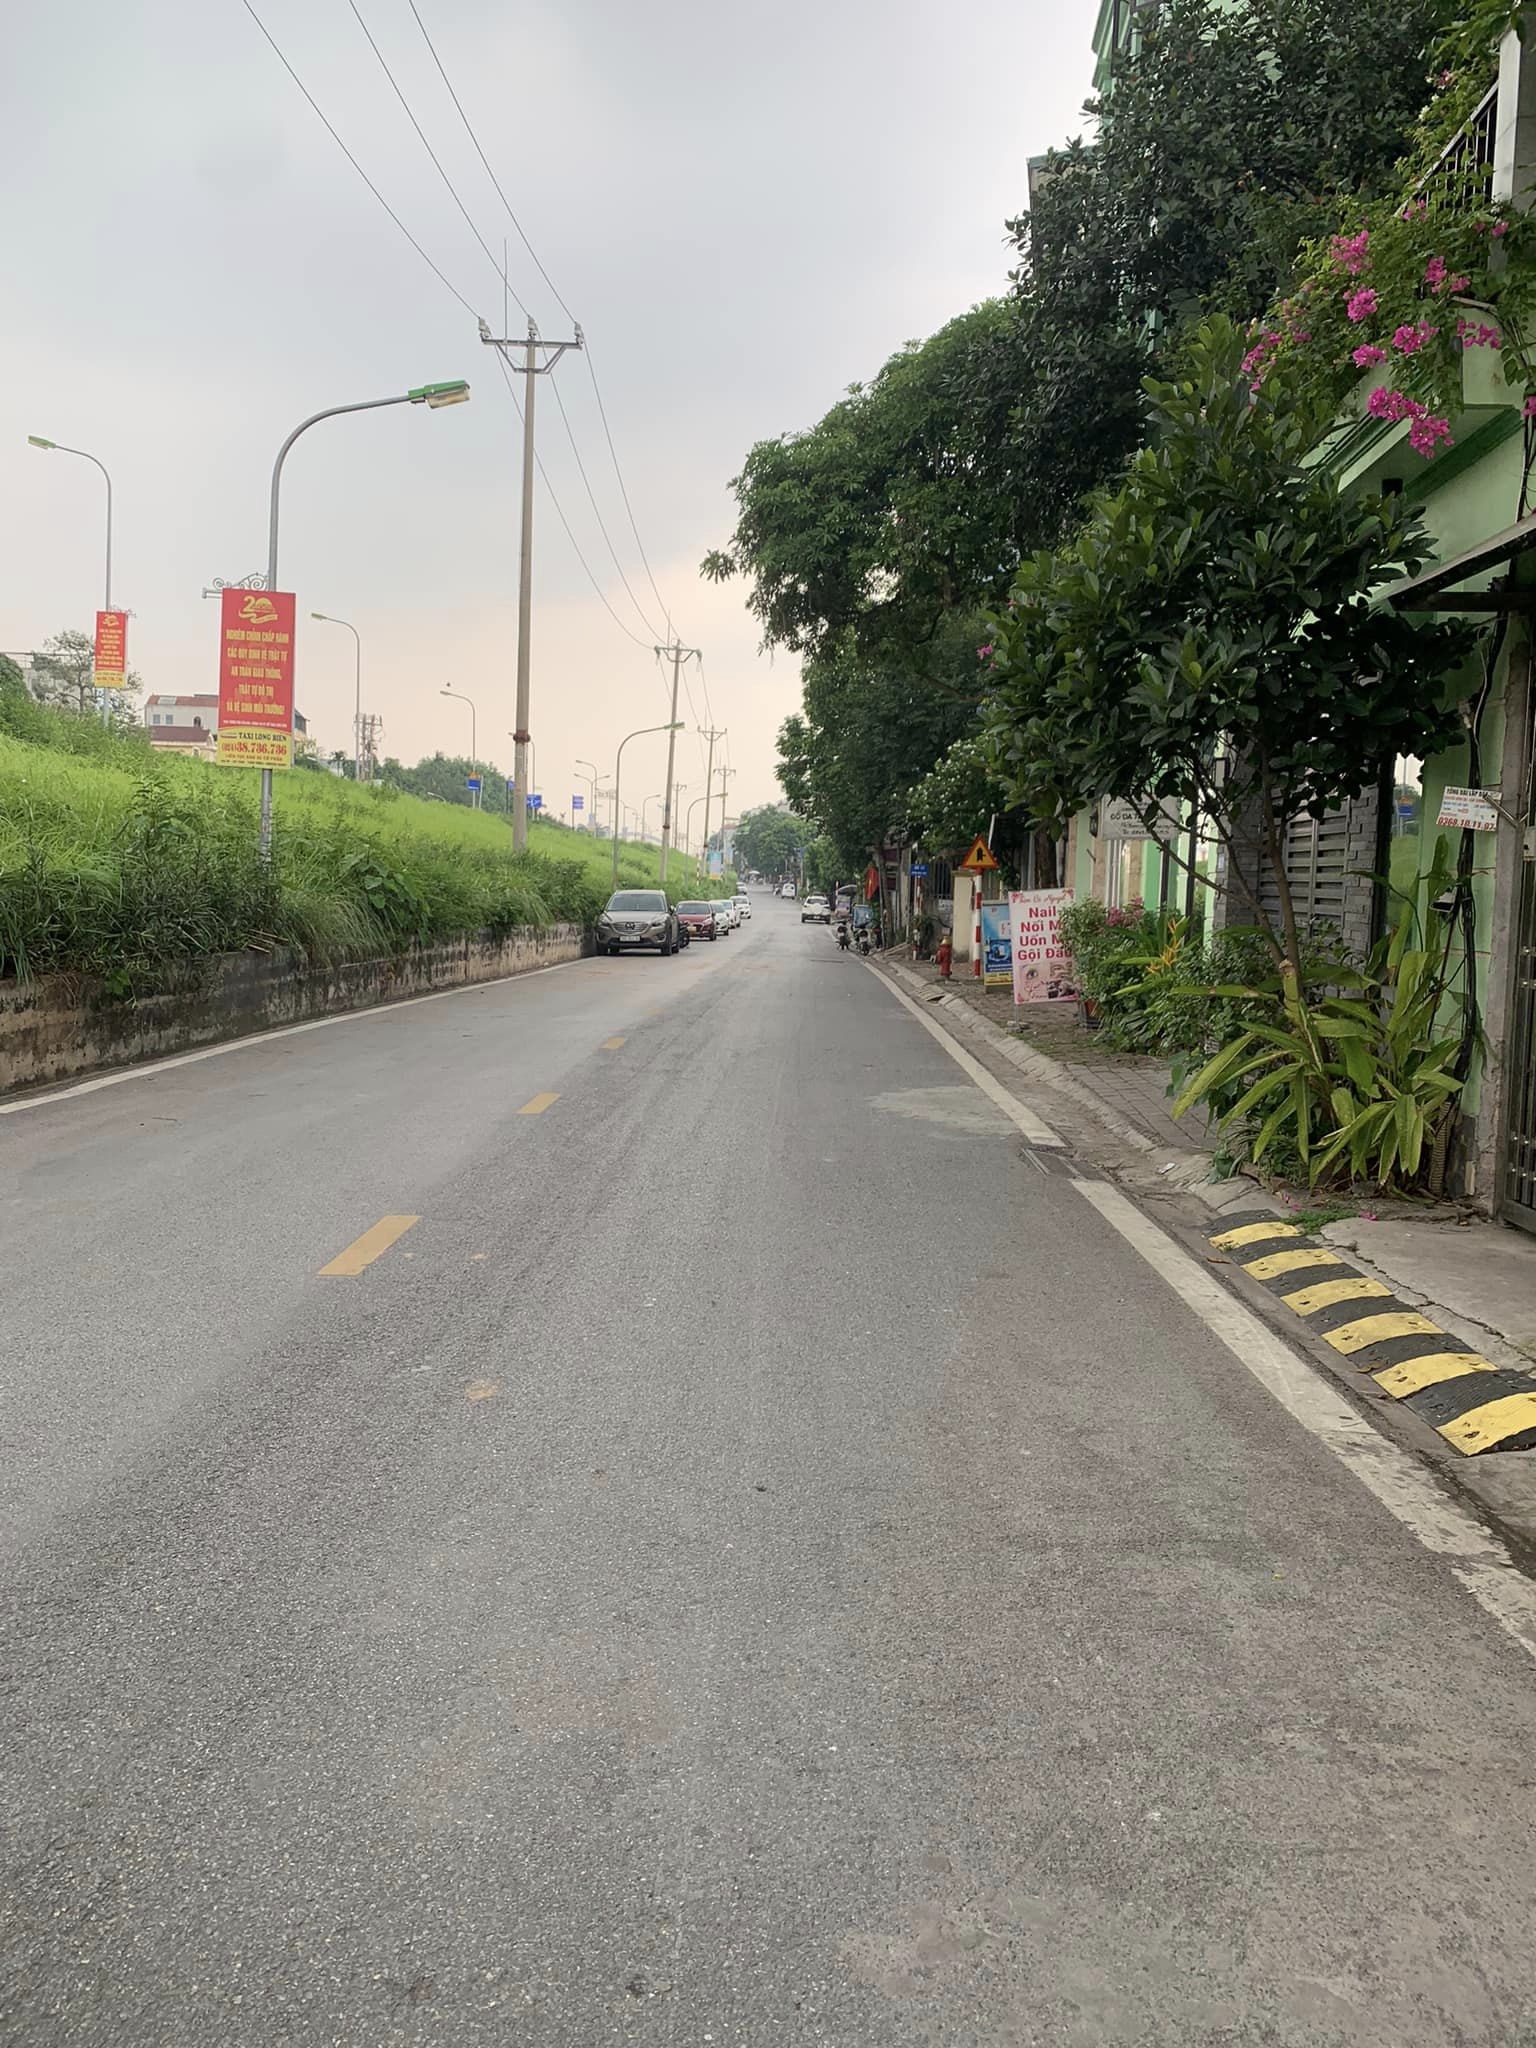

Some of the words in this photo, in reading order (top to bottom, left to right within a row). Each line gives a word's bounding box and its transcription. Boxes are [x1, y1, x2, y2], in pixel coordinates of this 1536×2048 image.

[239, 732, 254, 740] TAXI
[255, 733, 272, 741] LONG
[1029, 906, 1056, 918] Nail
[1020, 920, 1044, 933] Nối
[1049, 920, 1065, 931] M
[1020, 933, 1046, 946] Uốn
[1018, 948, 1040, 962] Gội
